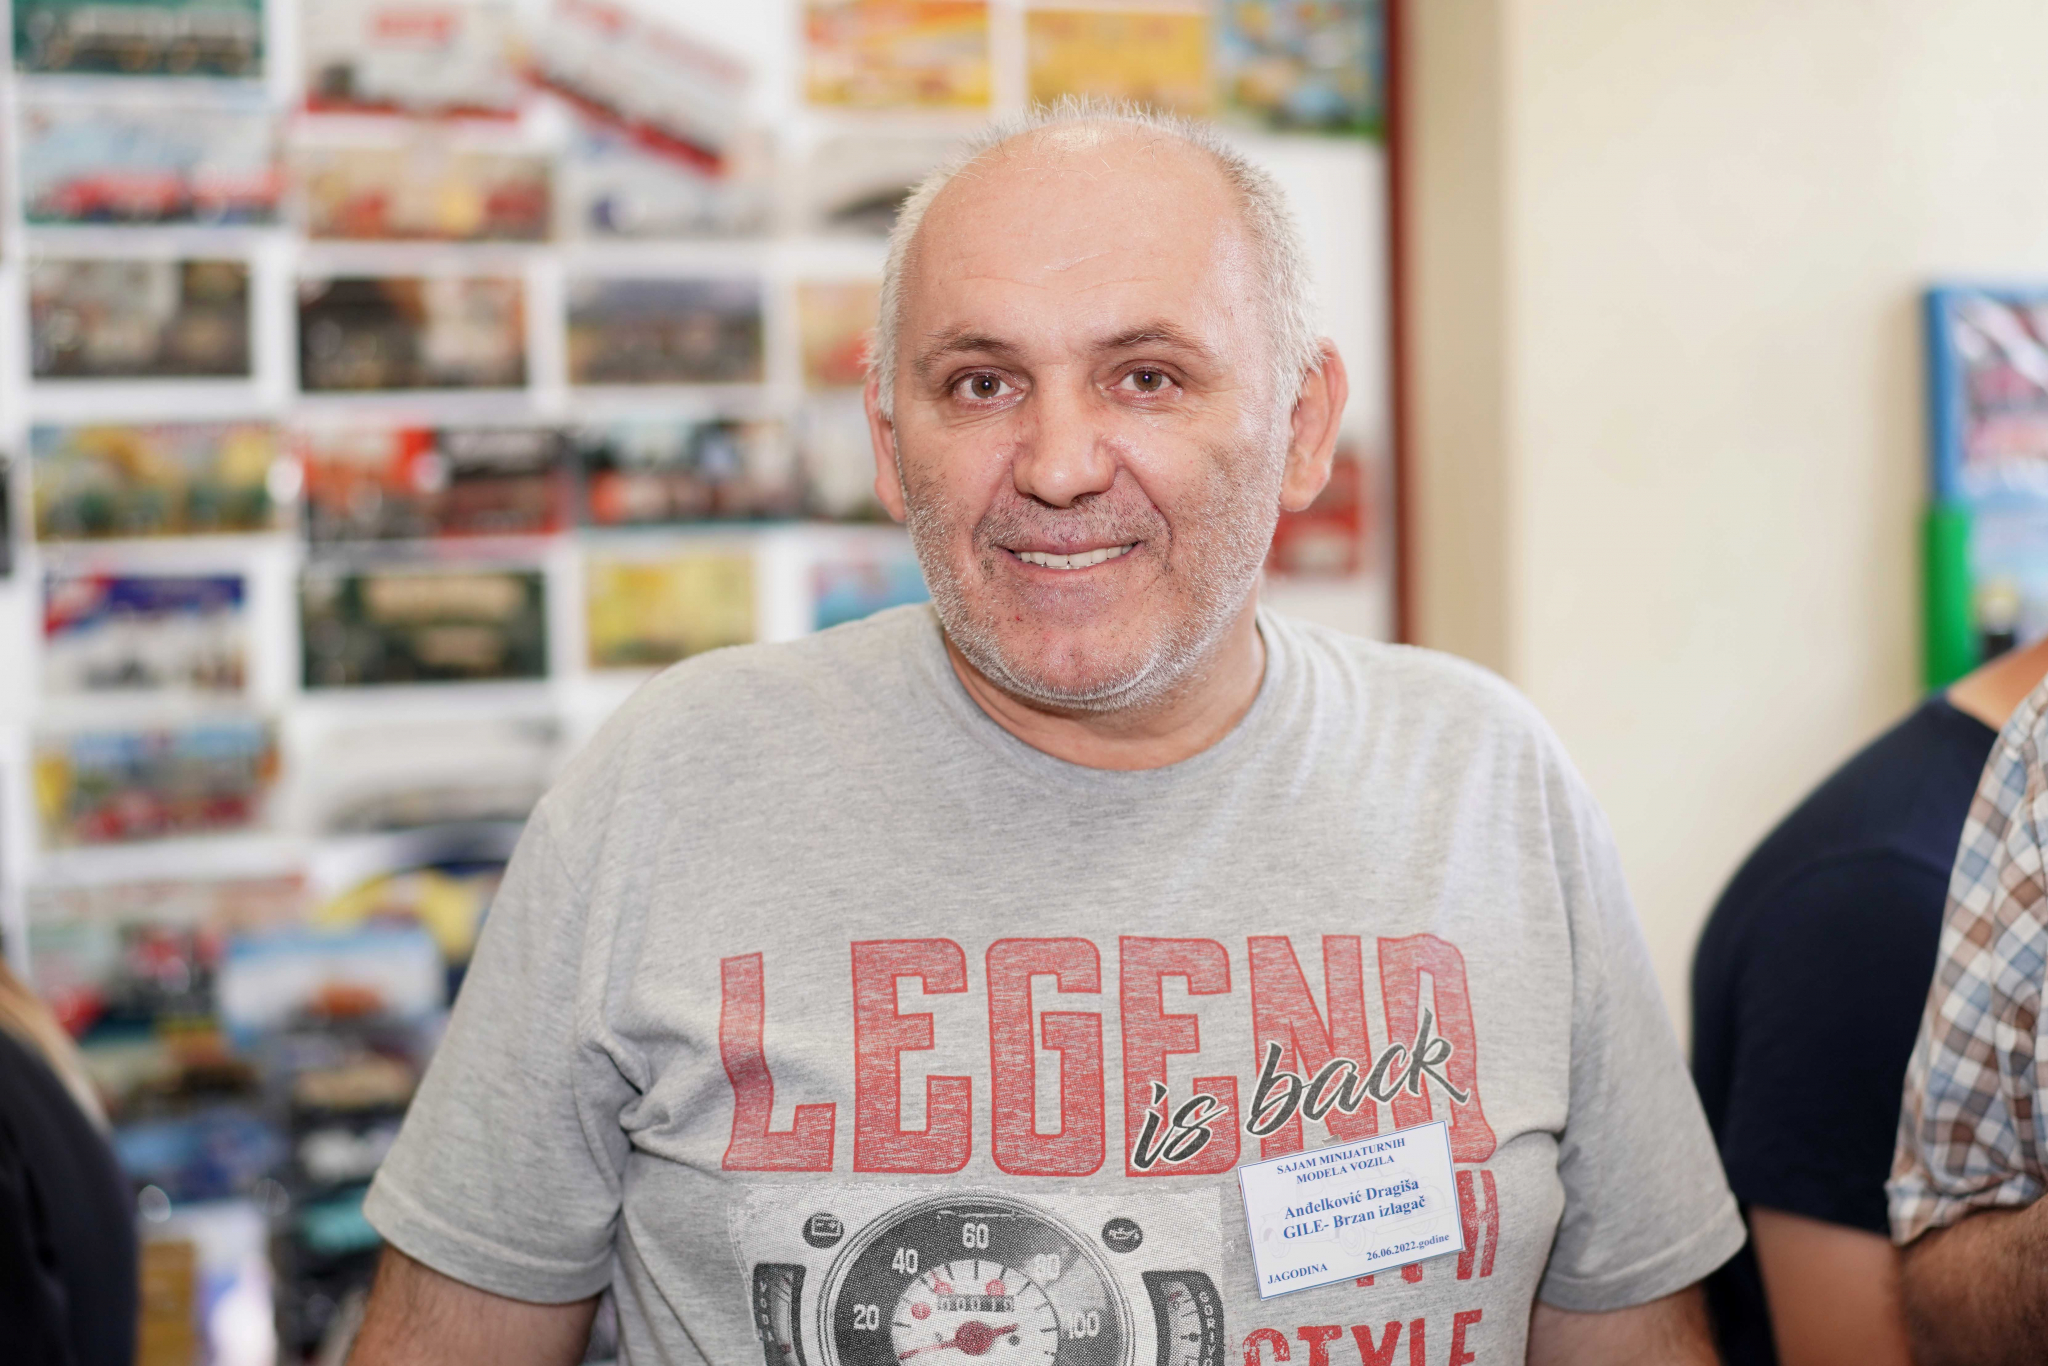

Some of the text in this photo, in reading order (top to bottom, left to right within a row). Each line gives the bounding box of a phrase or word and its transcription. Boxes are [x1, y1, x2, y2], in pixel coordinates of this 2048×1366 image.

[720, 934, 1497, 1176] LEGEND
[1131, 1006, 1471, 1170] is back
[1277, 1138, 1406, 1175] SAJAM MINIJATURNIH
[1296, 1155, 1395, 1184] MODELA VOZILA
[1285, 1178, 1420, 1220] Anđelković Dragiša
[1283, 1195, 1426, 1240] GILE- Brzan izlagač
[962, 1223, 989, 1249] 60
[1366, 1232, 1450, 1261] 26.06.2022.godine
[892, 1249, 919, 1274] 40
[1267, 1263, 1328, 1285] JAGODINA
[853, 1304, 880, 1330] 20
